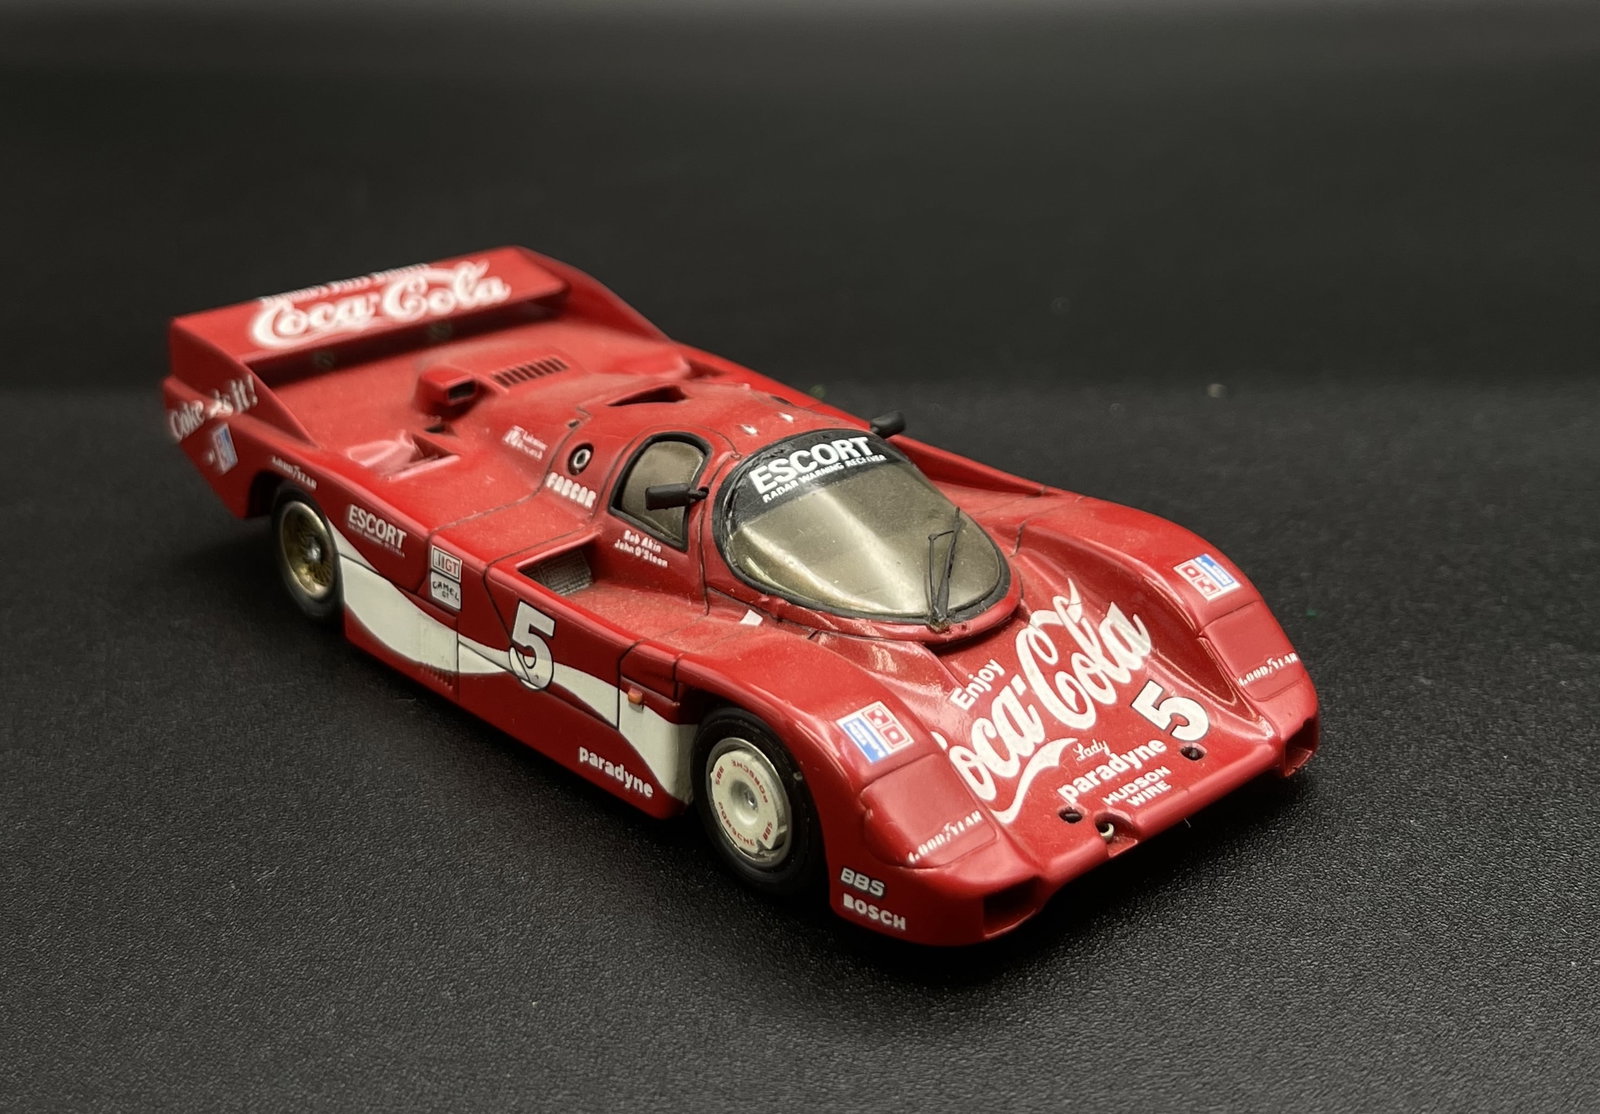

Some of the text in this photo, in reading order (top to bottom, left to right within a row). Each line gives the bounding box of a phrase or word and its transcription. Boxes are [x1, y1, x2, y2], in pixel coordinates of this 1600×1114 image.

[250, 260, 512, 349] Coca-Cola
[170, 400, 205, 441] Coke
[749, 436, 873, 495] ESCORT
[762, 480, 799, 503] RADAR
[800, 462, 845, 484] WARNING
[348, 504, 407, 548] ESCORT
[624, 530, 662, 553] Bob Akin
[432, 580, 460, 601] CAMEL
[509, 600, 556, 690] 5
[950, 658, 1005, 711] Enjoy
[1131, 678, 1210, 743] 5
[578, 747, 654, 797] paradyne
[1057, 740, 1167, 805] paradyne
[1102, 766, 1171, 805] HUDSON
[1126, 780, 1172, 806] WIRE
[841, 867, 885, 897] BBS
[843, 892, 906, 931] BOSCH
